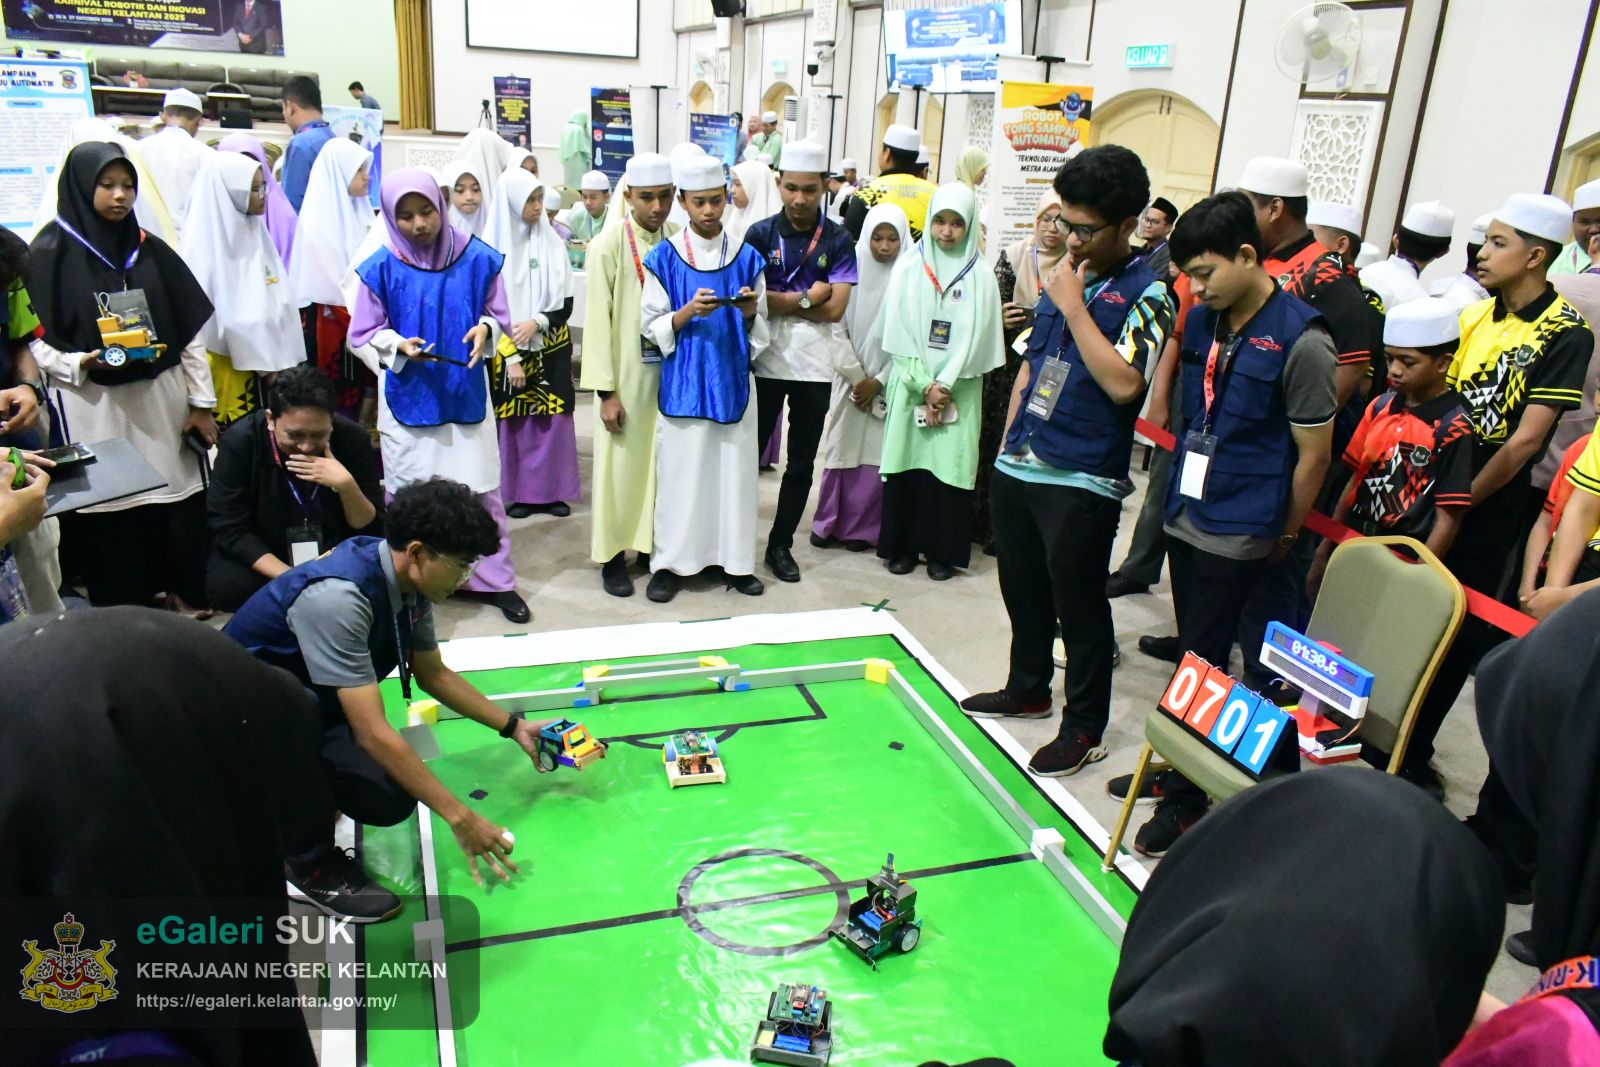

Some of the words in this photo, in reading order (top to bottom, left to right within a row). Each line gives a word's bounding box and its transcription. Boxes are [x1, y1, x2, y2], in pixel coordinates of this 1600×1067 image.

[77, 7, 111, 16] NEGERI
[112, 9, 162, 19] KELANTAN
[164, 13, 185, 21] 2025
[103, 1, 145, 10] ROBOTIK
[146, 4, 167, 12] DAN
[168, 5, 206, 15] INOVASI
[1127, 46, 1168, 65] KELUAR
[1024, 110, 1061, 121] ROBOT
[1005, 123, 1034, 133] TONG
[1037, 123, 1079, 137] SAMPAH
[1012, 134, 1070, 148] AUTOMATIK
[1020, 164, 1041, 172] MESRA
[1291, 640, 1338, 676] 01:30.6
